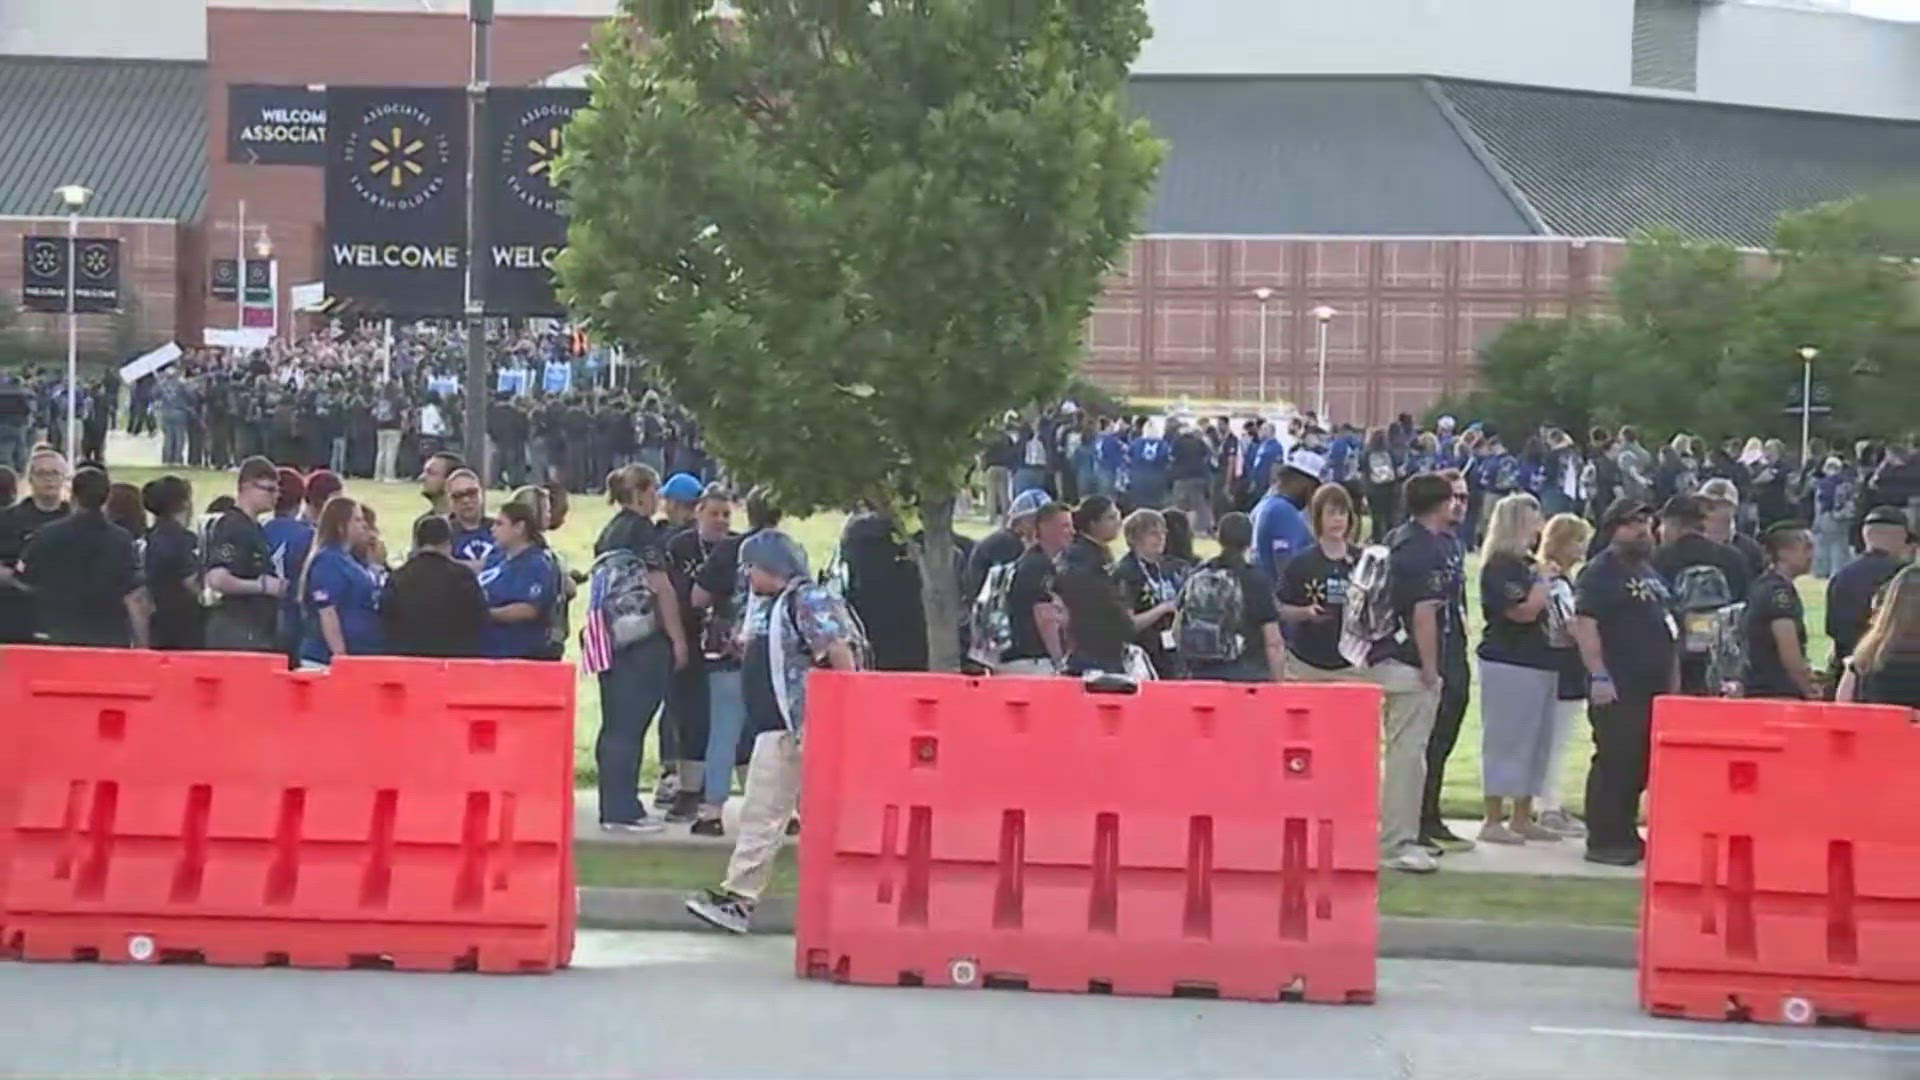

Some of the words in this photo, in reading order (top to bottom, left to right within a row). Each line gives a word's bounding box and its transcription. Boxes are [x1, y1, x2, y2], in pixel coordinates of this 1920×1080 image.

[363, 103, 431, 127] ASSOCIATES
[350, 174, 444, 210] SHAREHOLDERS
[332, 244, 459, 268] WELCOME
[491, 245, 561, 269] WELC
